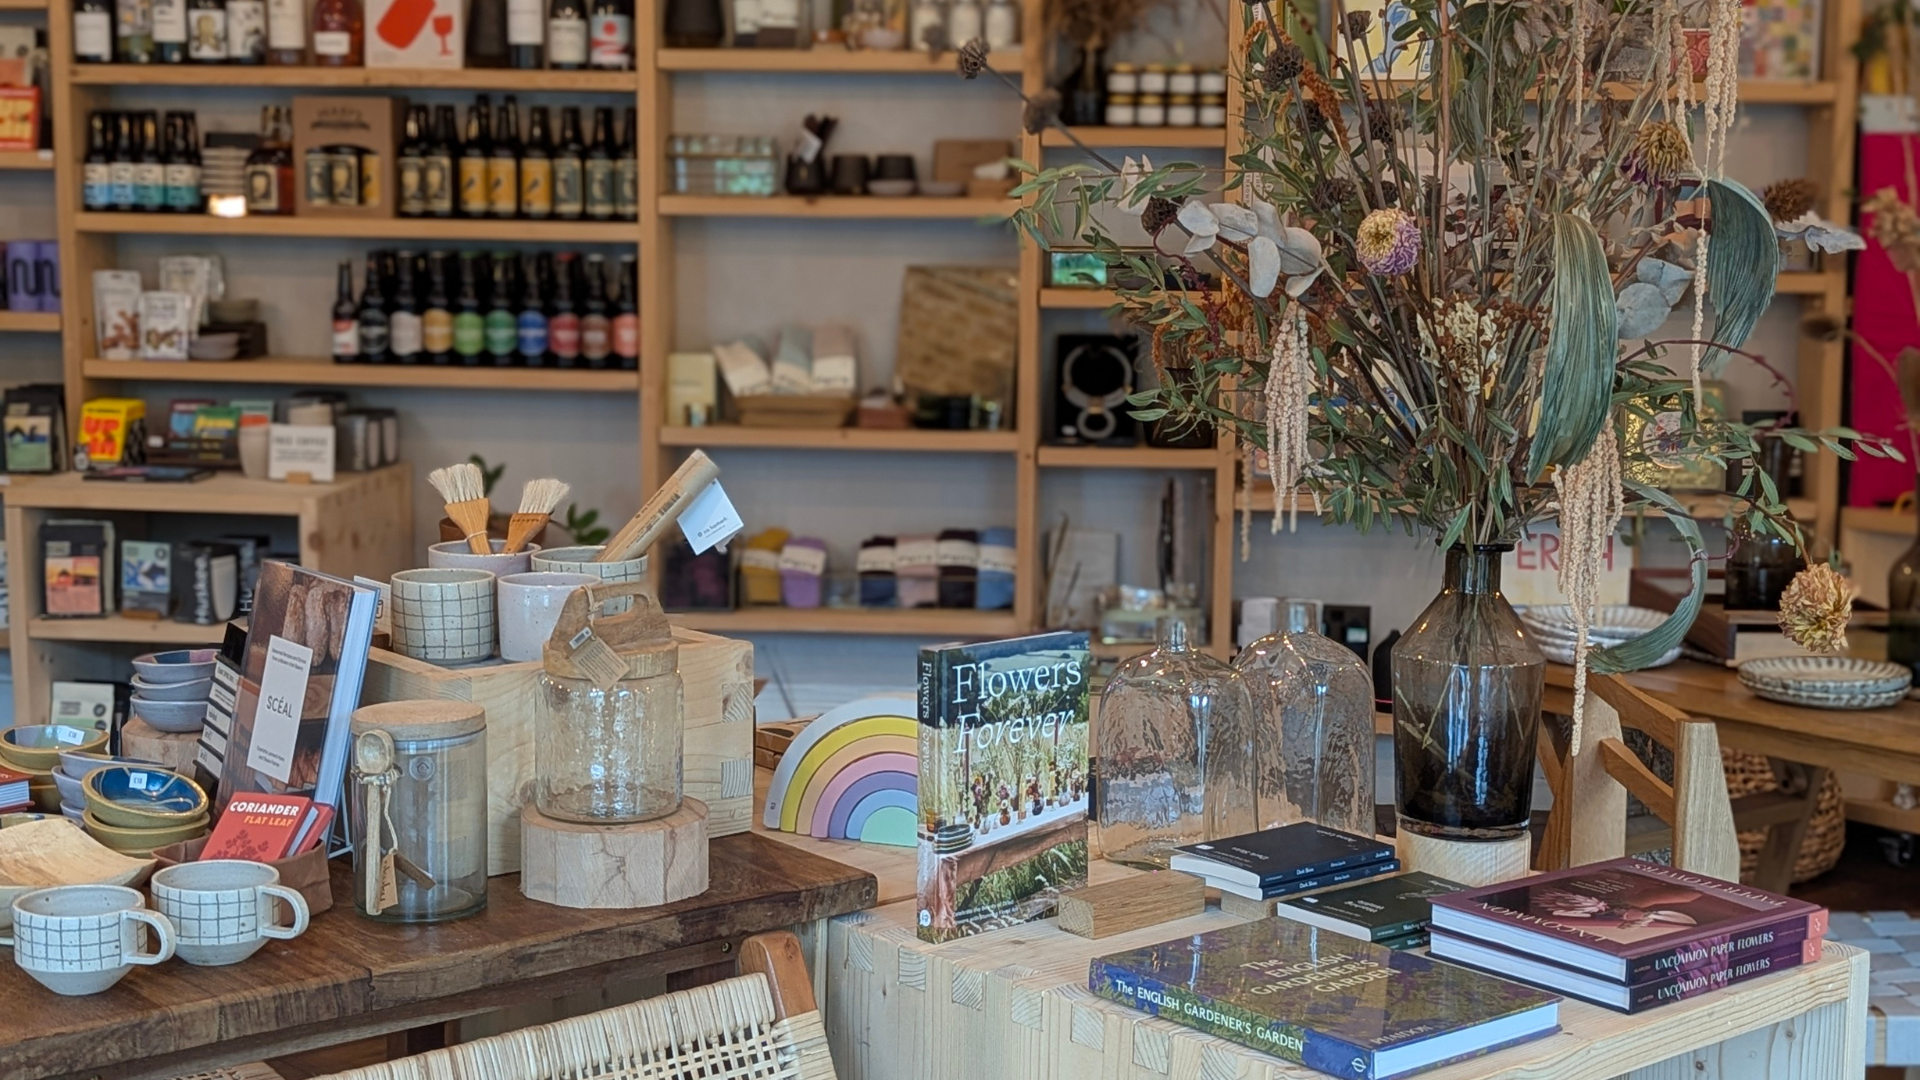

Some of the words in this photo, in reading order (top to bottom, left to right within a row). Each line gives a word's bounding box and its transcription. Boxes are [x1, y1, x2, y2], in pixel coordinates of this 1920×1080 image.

[922, 661, 932, 719] Flowers
[952, 660, 1081, 704] Flowers
[266, 695, 293, 719] SCÉAL
[922, 726, 932, 777] Forever
[952, 709, 1075, 754] Forever
[229, 801, 300, 817] CORIANDER
[244, 815, 266, 826] FLAT
[268, 817, 294, 827] LEAF
[1477, 902, 1607, 942] UNCOMMON
[1239, 958, 1284, 971] The
[1265, 953, 1354, 979] ENGLISH
[1655, 949, 1709, 971] UNCOMMON
[1710, 942, 1735, 961] PAPER
[1737, 931, 1775, 951] FLOWERS
[1250, 959, 1379, 995] GARDENER'S
[1314, 967, 1402, 993] GARDEN
[1657, 976, 1709, 999] UNCOMMON
[1710, 968, 1734, 986] PAPER
[1735, 957, 1771, 977] FLOWERS
[1115, 979, 1134, 995] The
[1137, 986, 1180, 1011] ENGLISH
[1184, 1002, 1252, 1035] GARDENER'S
[1256, 1027, 1304, 1052] GARDEN
